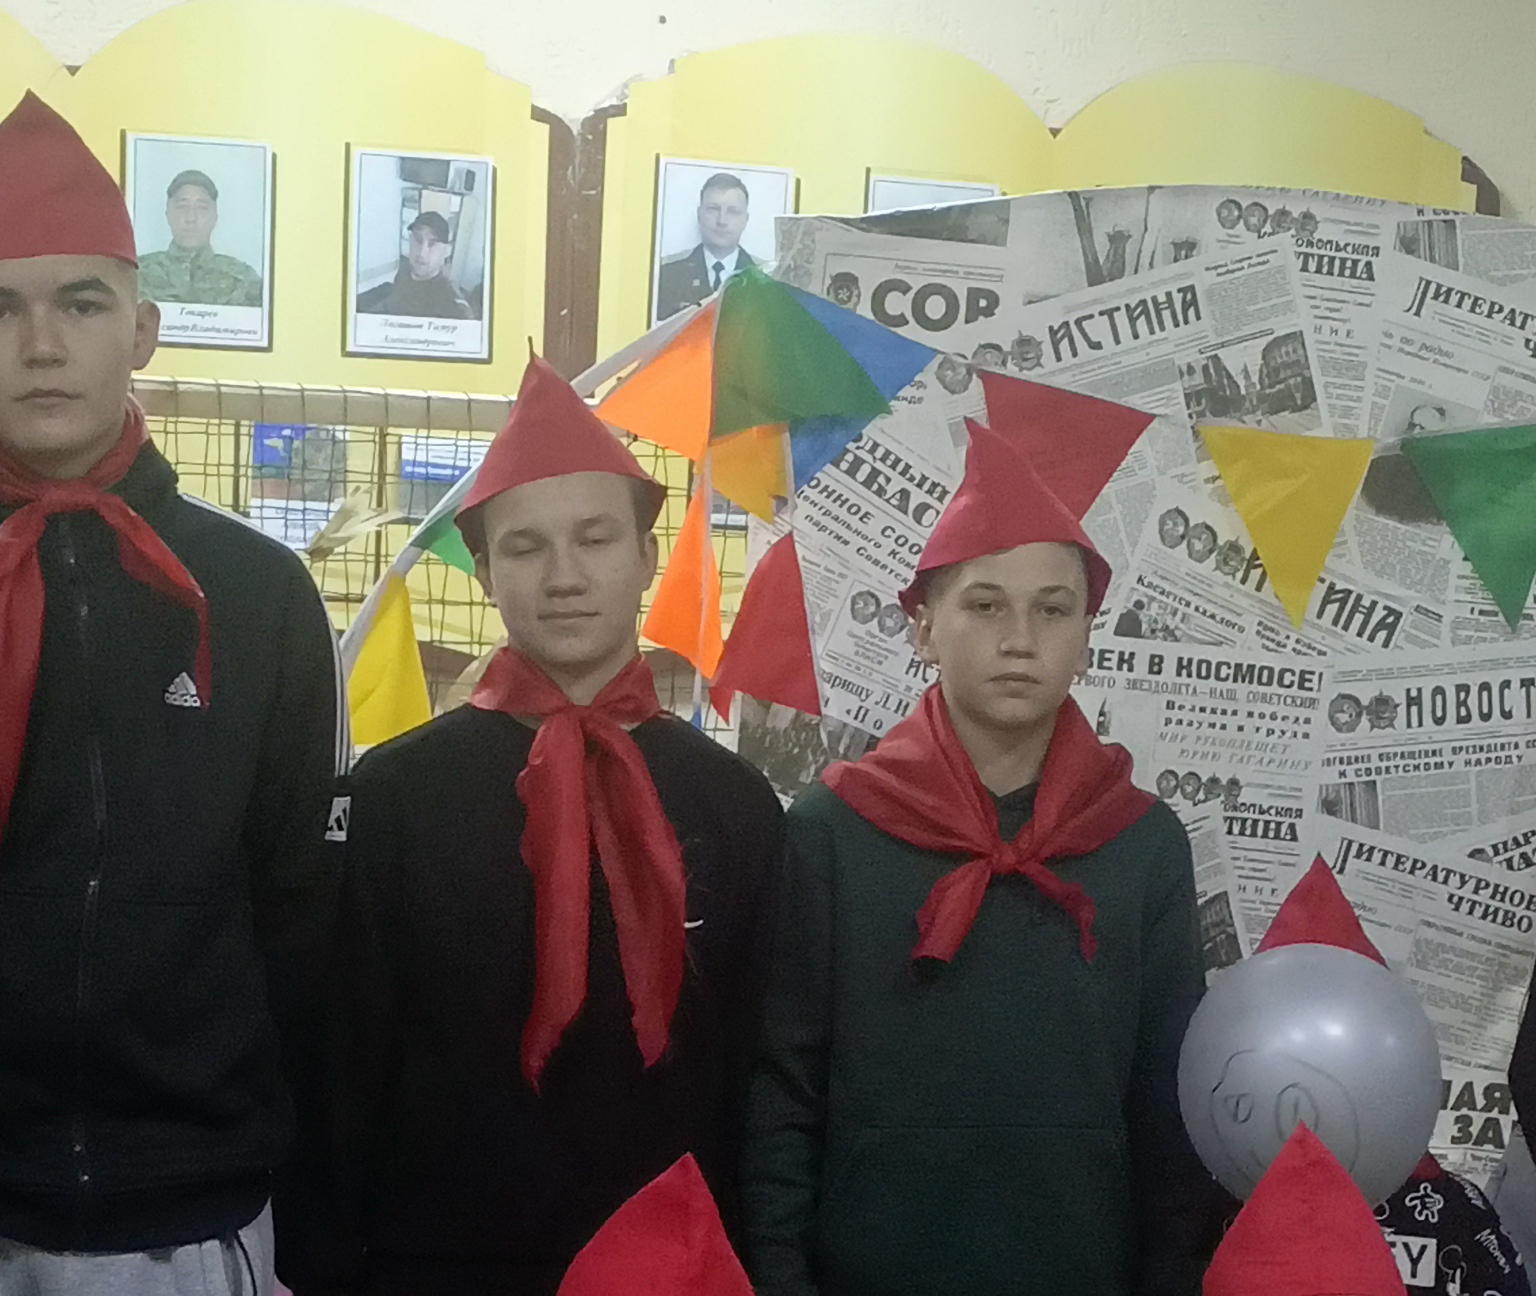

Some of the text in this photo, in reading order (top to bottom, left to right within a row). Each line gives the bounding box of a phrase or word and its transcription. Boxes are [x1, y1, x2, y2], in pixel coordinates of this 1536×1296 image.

[1290, 234, 1381, 258] ОМОЛЬСКАЯ
[1048, 283, 1202, 363] ИСТИНА
[804, 514, 851, 548] партии
[1148, 653, 1164, 676] В
[1175, 656, 1323, 693] КОСМОСЕ!
[1464, 753, 1525, 768] НАРОДУ
[1447, 893, 1533, 934] ЧТИВО
